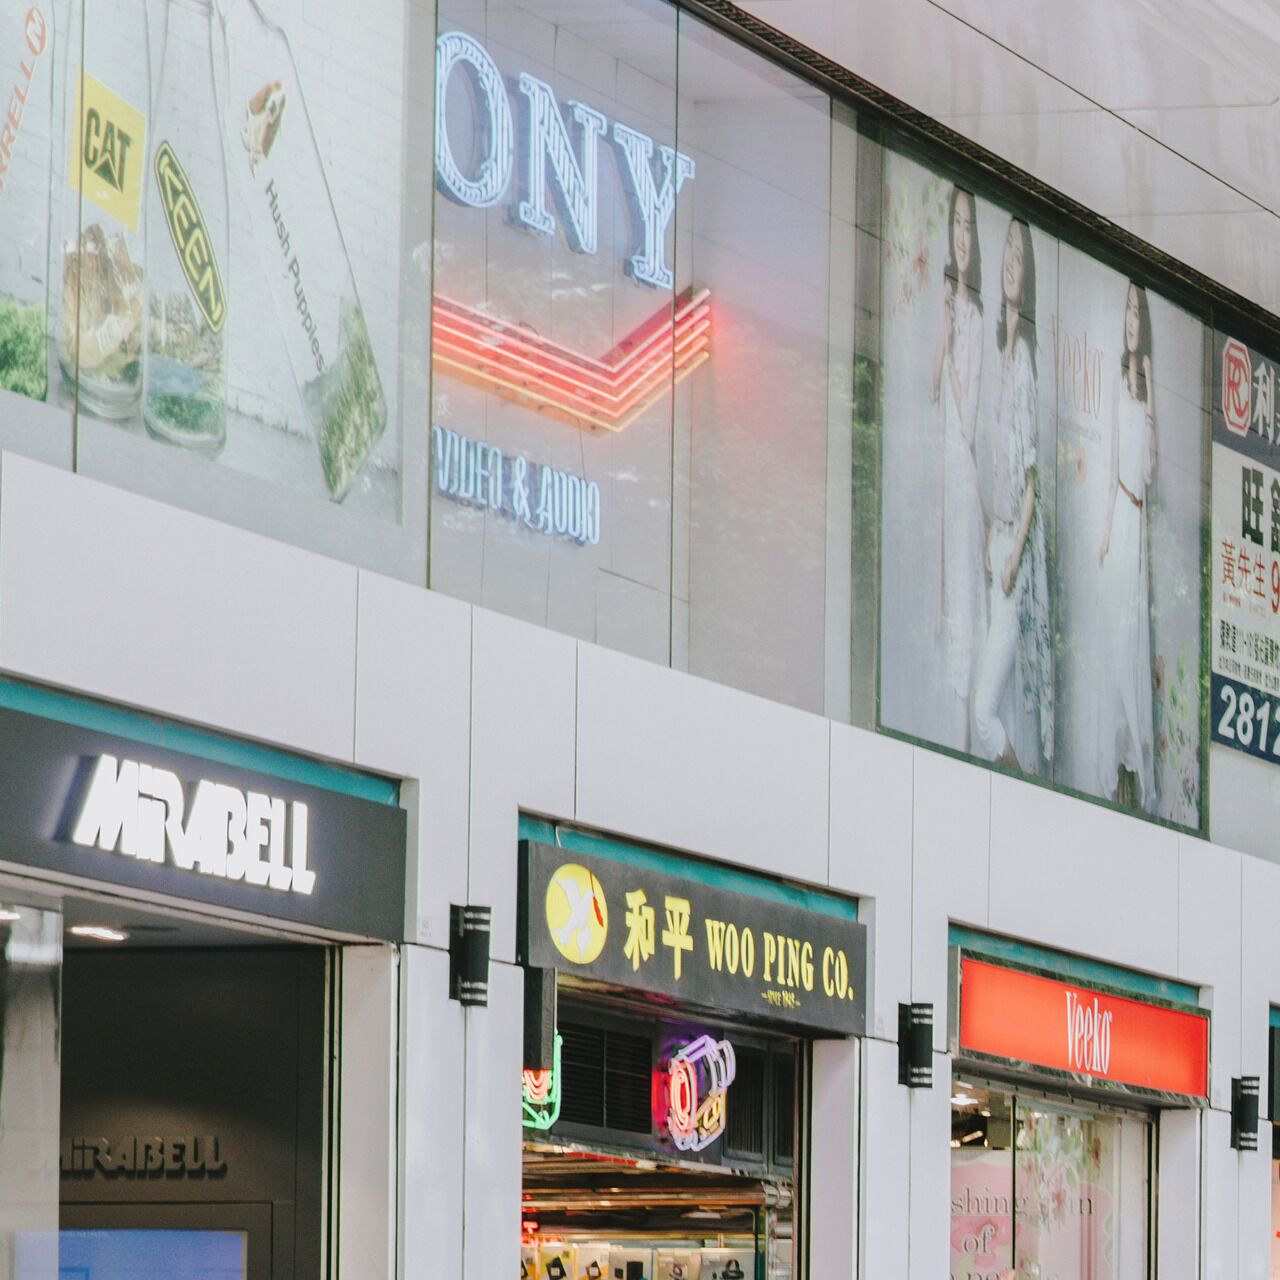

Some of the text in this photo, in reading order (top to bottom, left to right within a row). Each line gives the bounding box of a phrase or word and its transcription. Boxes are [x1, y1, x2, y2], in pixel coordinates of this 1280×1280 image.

[84, 107, 131, 193] CAT
[158, 155, 222, 323] KEEN
[265, 179, 325, 373] Hush Puppies
[513, 455, 532, 527] &
[539, 466, 600, 546] AUDIO
[624, 888, 694, 980] 和平
[705, 918, 854, 1001] WOO PING CO.
[1065, 991, 1112, 1075] Veeko
[963, 1227, 997, 1254] of
